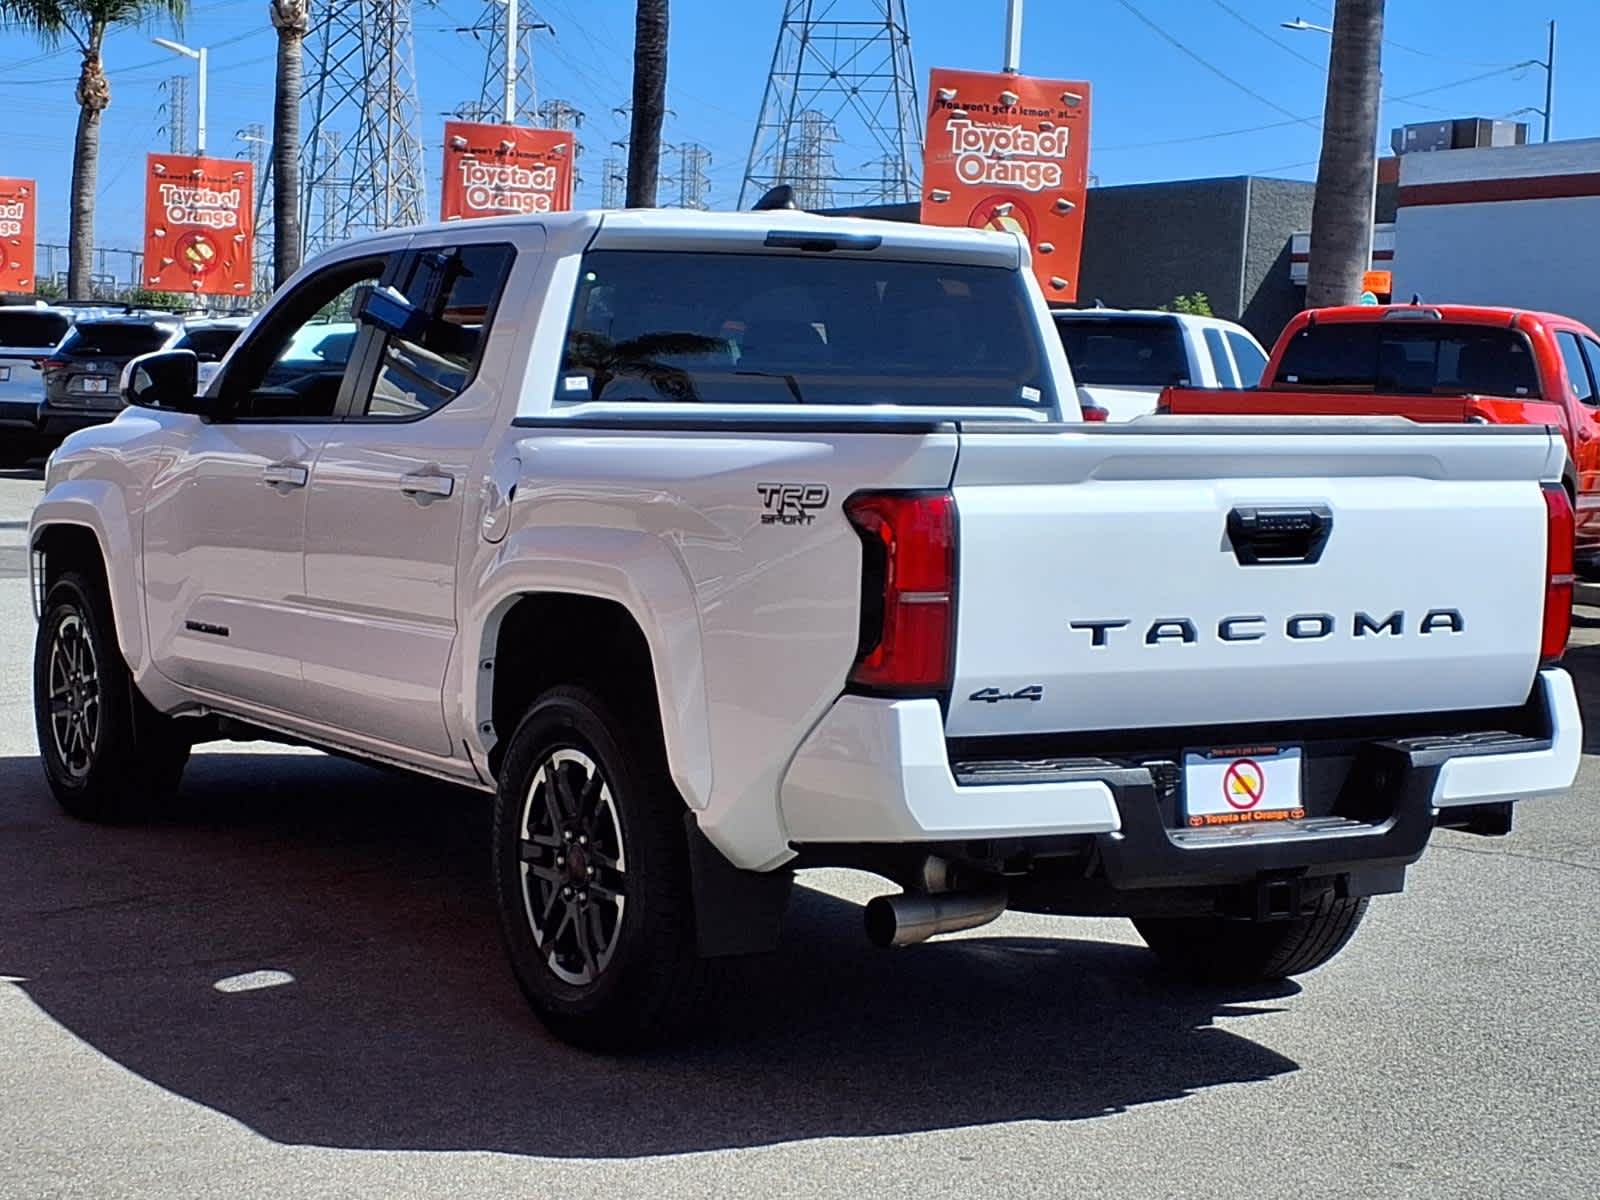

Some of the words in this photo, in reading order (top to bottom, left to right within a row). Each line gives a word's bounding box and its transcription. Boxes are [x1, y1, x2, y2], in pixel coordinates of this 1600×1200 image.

[963, 103, 990, 112] won't
[992, 104, 1009, 115] get
[946, 119, 1038, 156] Toyota
[1038, 126, 1069, 158] of
[459, 160, 532, 187] Toyota
[531, 167, 557, 190] of
[956, 151, 1062, 192] Orange
[159, 183, 219, 206] Toyota
[219, 188, 241, 208] of
[466, 184, 551, 214] Orange
[166, 204, 237, 229] Orange
[757, 482, 829, 516] TRD
[761, 514, 816, 525] SPORT
[1069, 607, 1465, 647] TACOMA
[1204, 814, 1239, 825] Toyota
[1241, 811, 1252, 820] of
[1253, 810, 1289, 820] Orange
